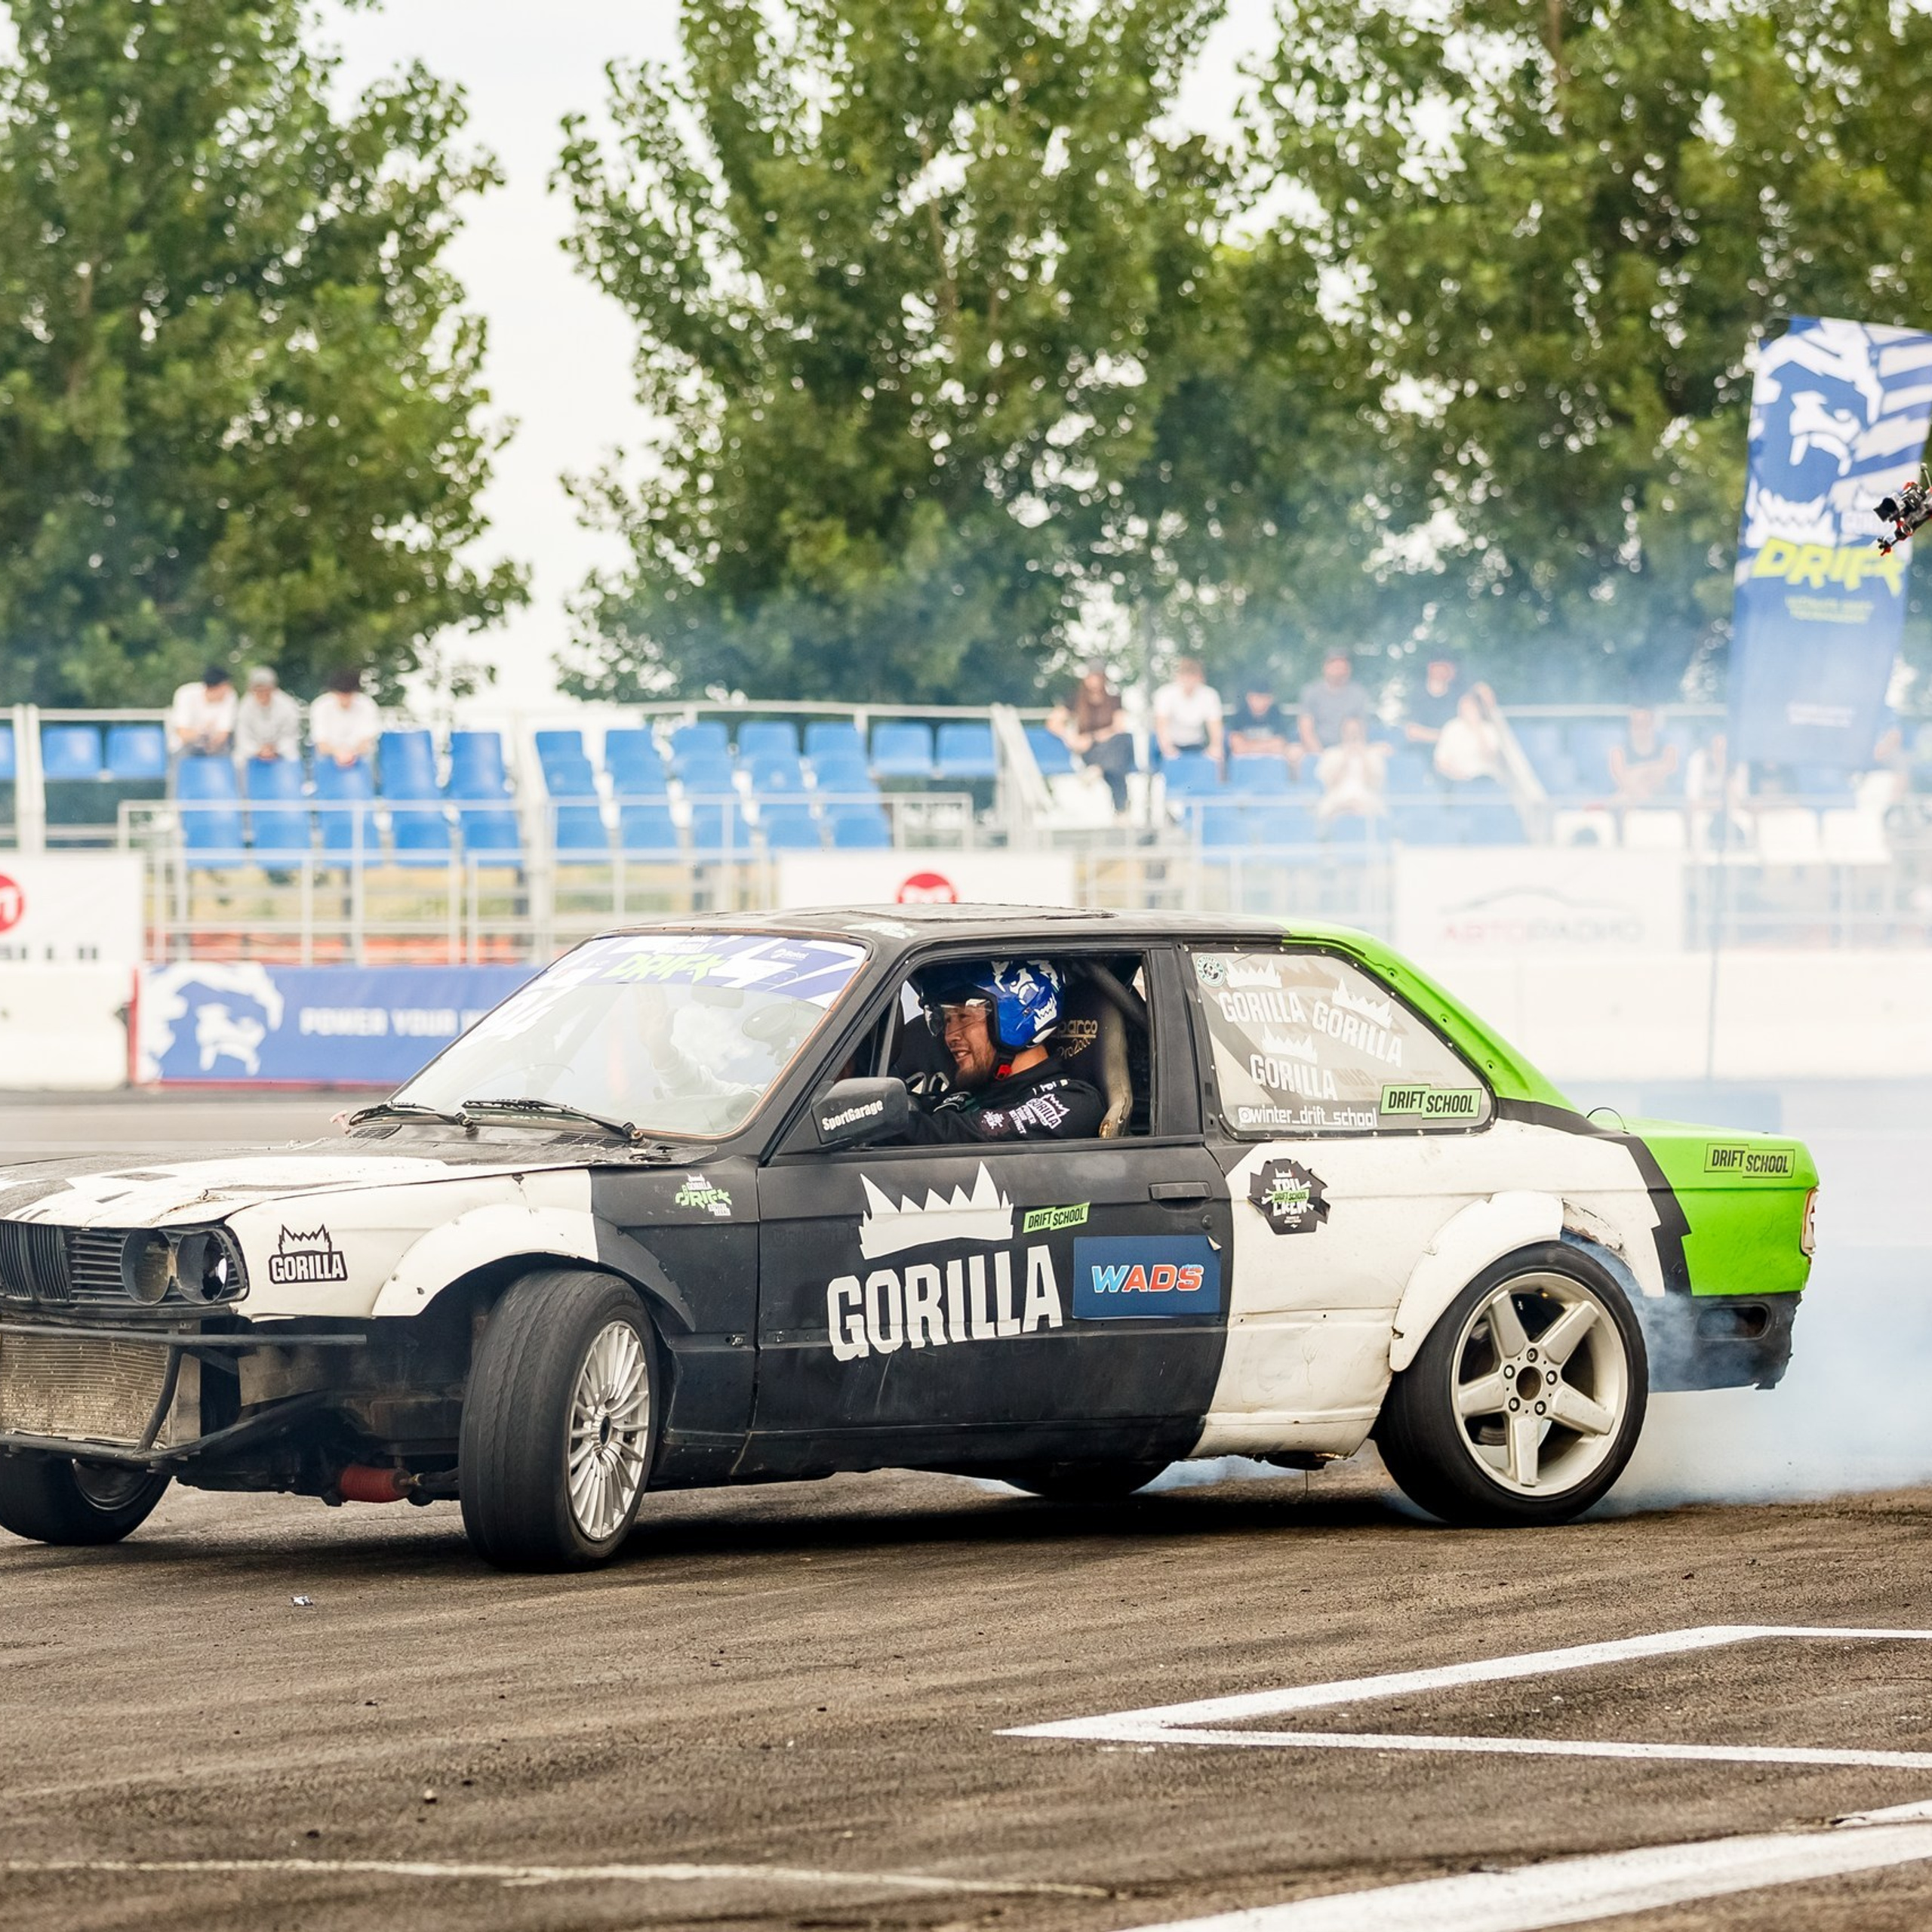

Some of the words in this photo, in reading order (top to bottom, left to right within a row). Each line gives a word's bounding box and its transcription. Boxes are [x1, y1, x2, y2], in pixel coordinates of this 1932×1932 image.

[1218, 992, 1307, 1023] GORILLA
[300, 1008, 388, 1036] POWER
[391, 1008, 458, 1037] YOUR
[1057, 1020, 1098, 1038] parco
[1312, 1001, 1403, 1067] GORILLA
[1250, 1054, 1339, 1100] GORILLA
[822, 1100, 884, 1131] SportGarage
[1388, 1091, 1426, 1109] DRIFT
[1426, 1095, 1474, 1112] SCHOOL
[1712, 1149, 1746, 1168] DRIFT
[1746, 1155, 1789, 1173] SCHOOL
[1028, 1211, 1053, 1229] DRIFT
[1053, 1208, 1084, 1226] SCHOOL
[272, 1253, 345, 1281] GORILLA
[1091, 1263, 1204, 1293] WADS
[826, 1244, 1063, 1361] GORILLA
